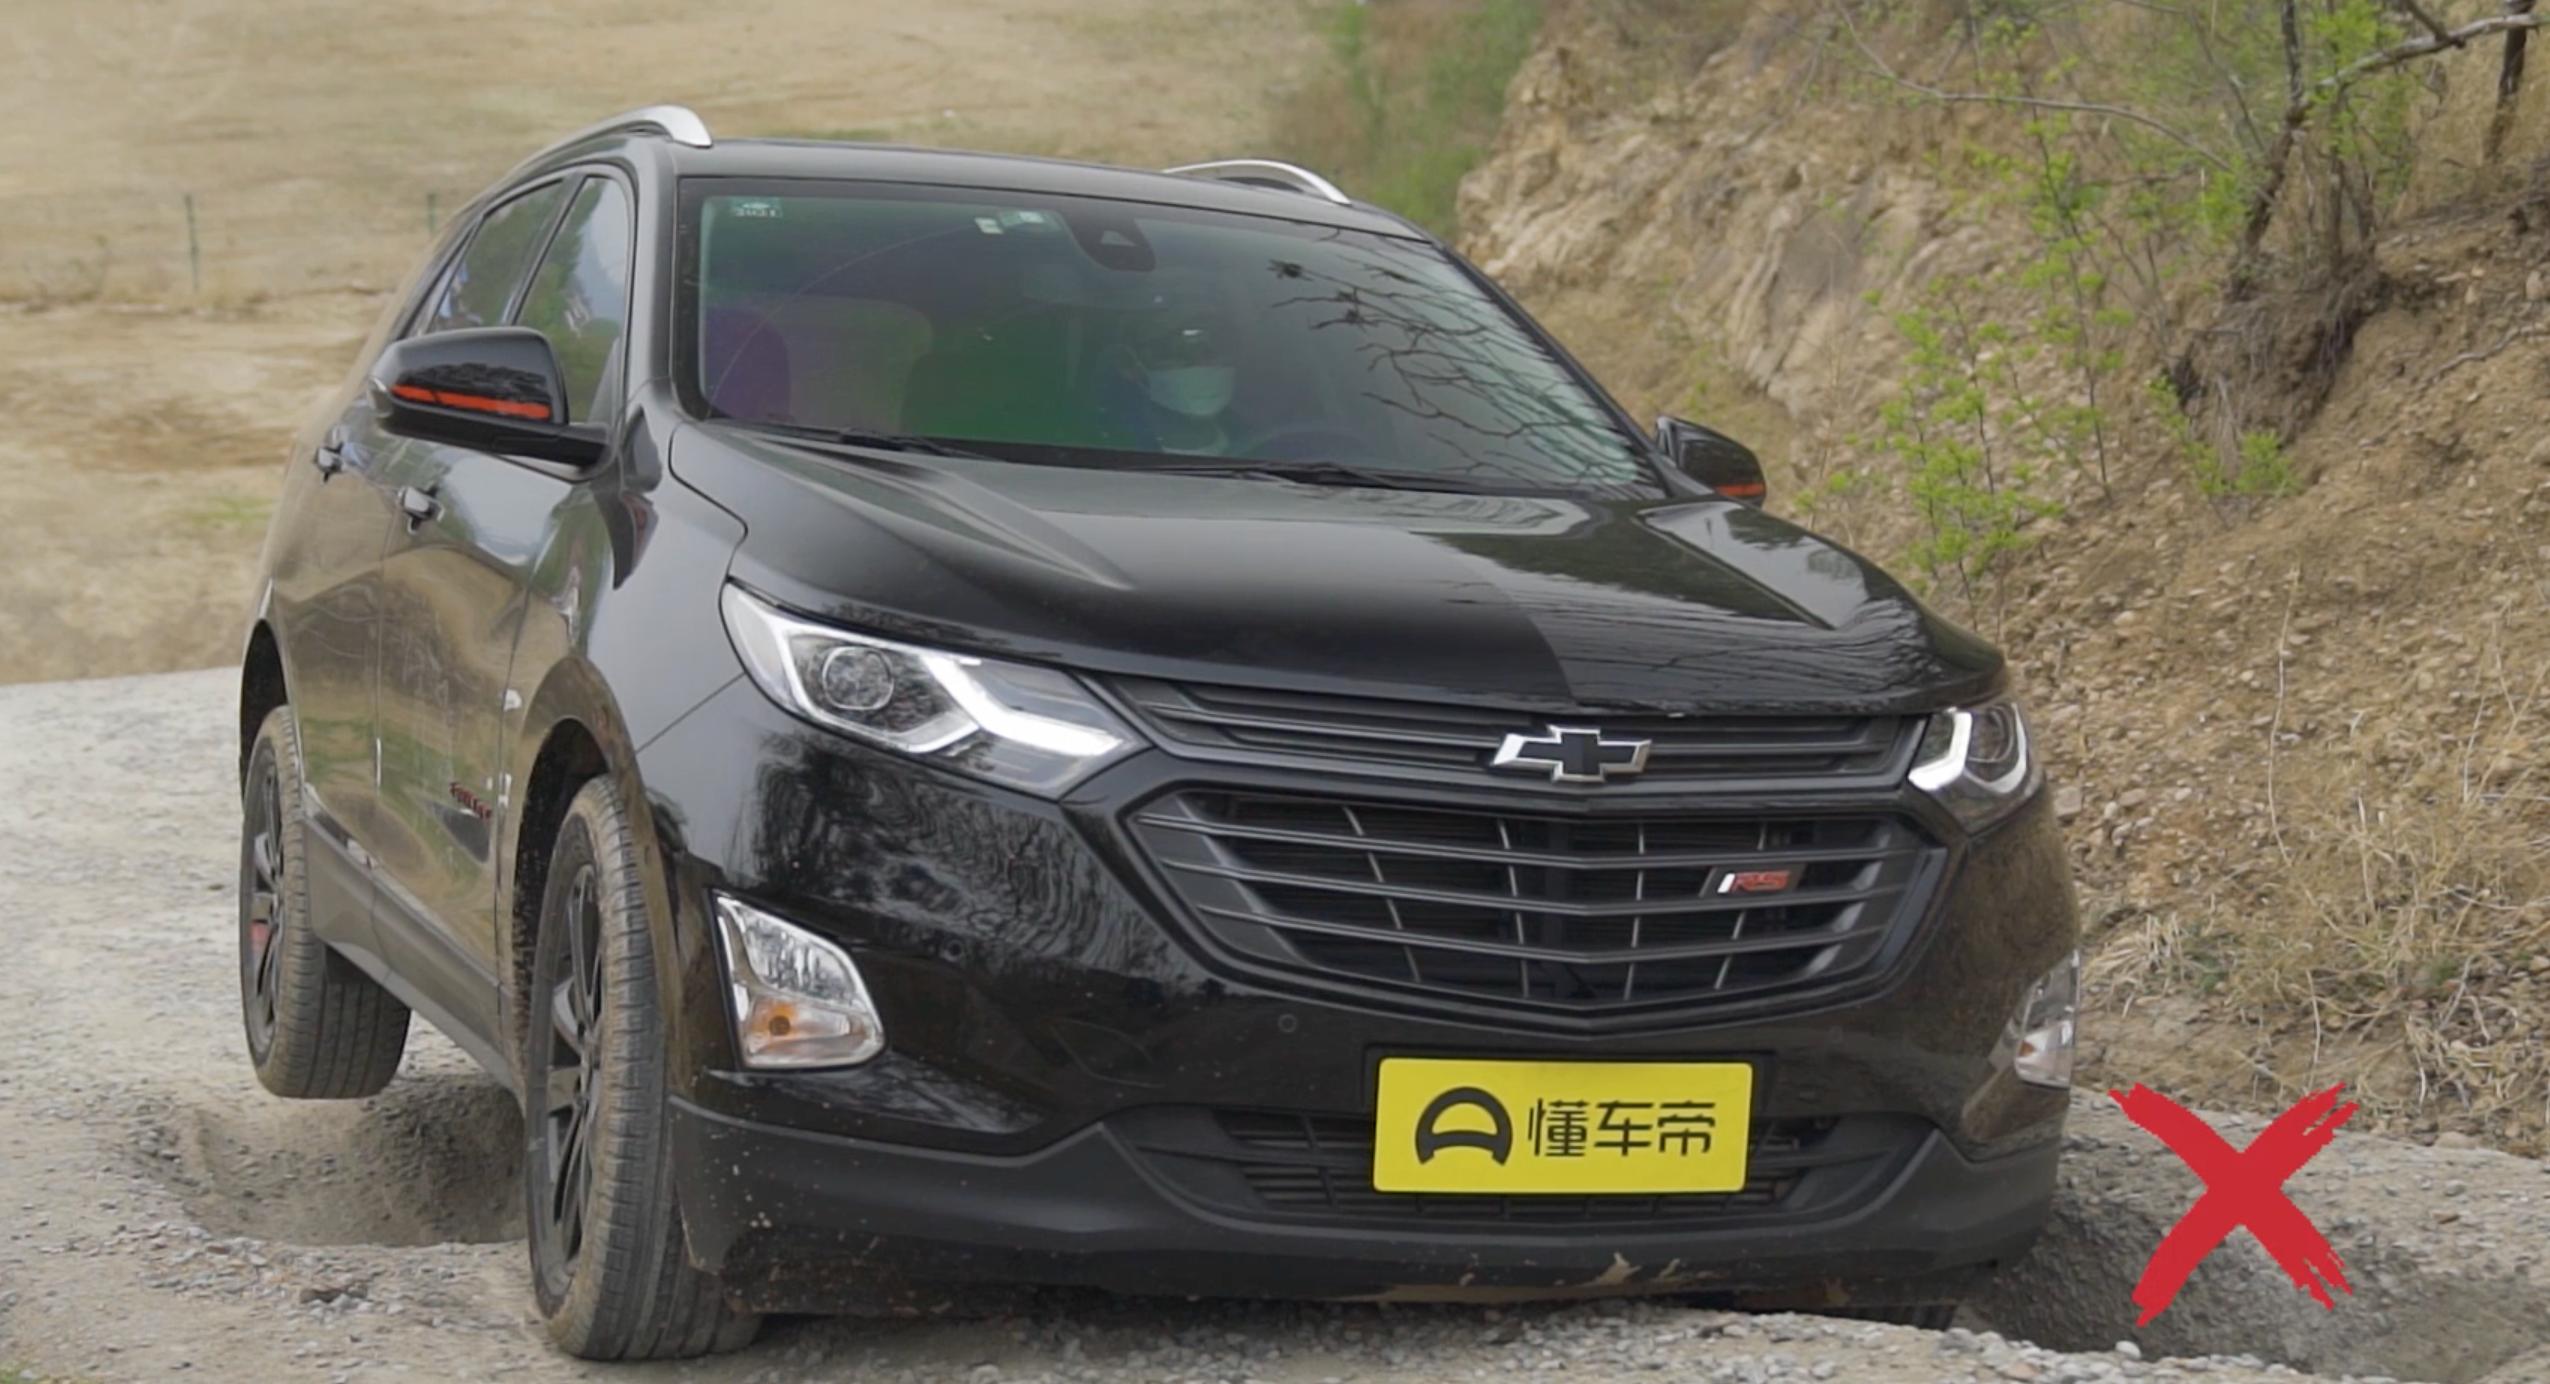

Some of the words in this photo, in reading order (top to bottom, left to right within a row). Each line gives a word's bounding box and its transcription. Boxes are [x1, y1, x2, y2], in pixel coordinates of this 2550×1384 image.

[1729, 870, 1790, 893] RS
[1528, 1098, 1716, 1157] 懂车帝
